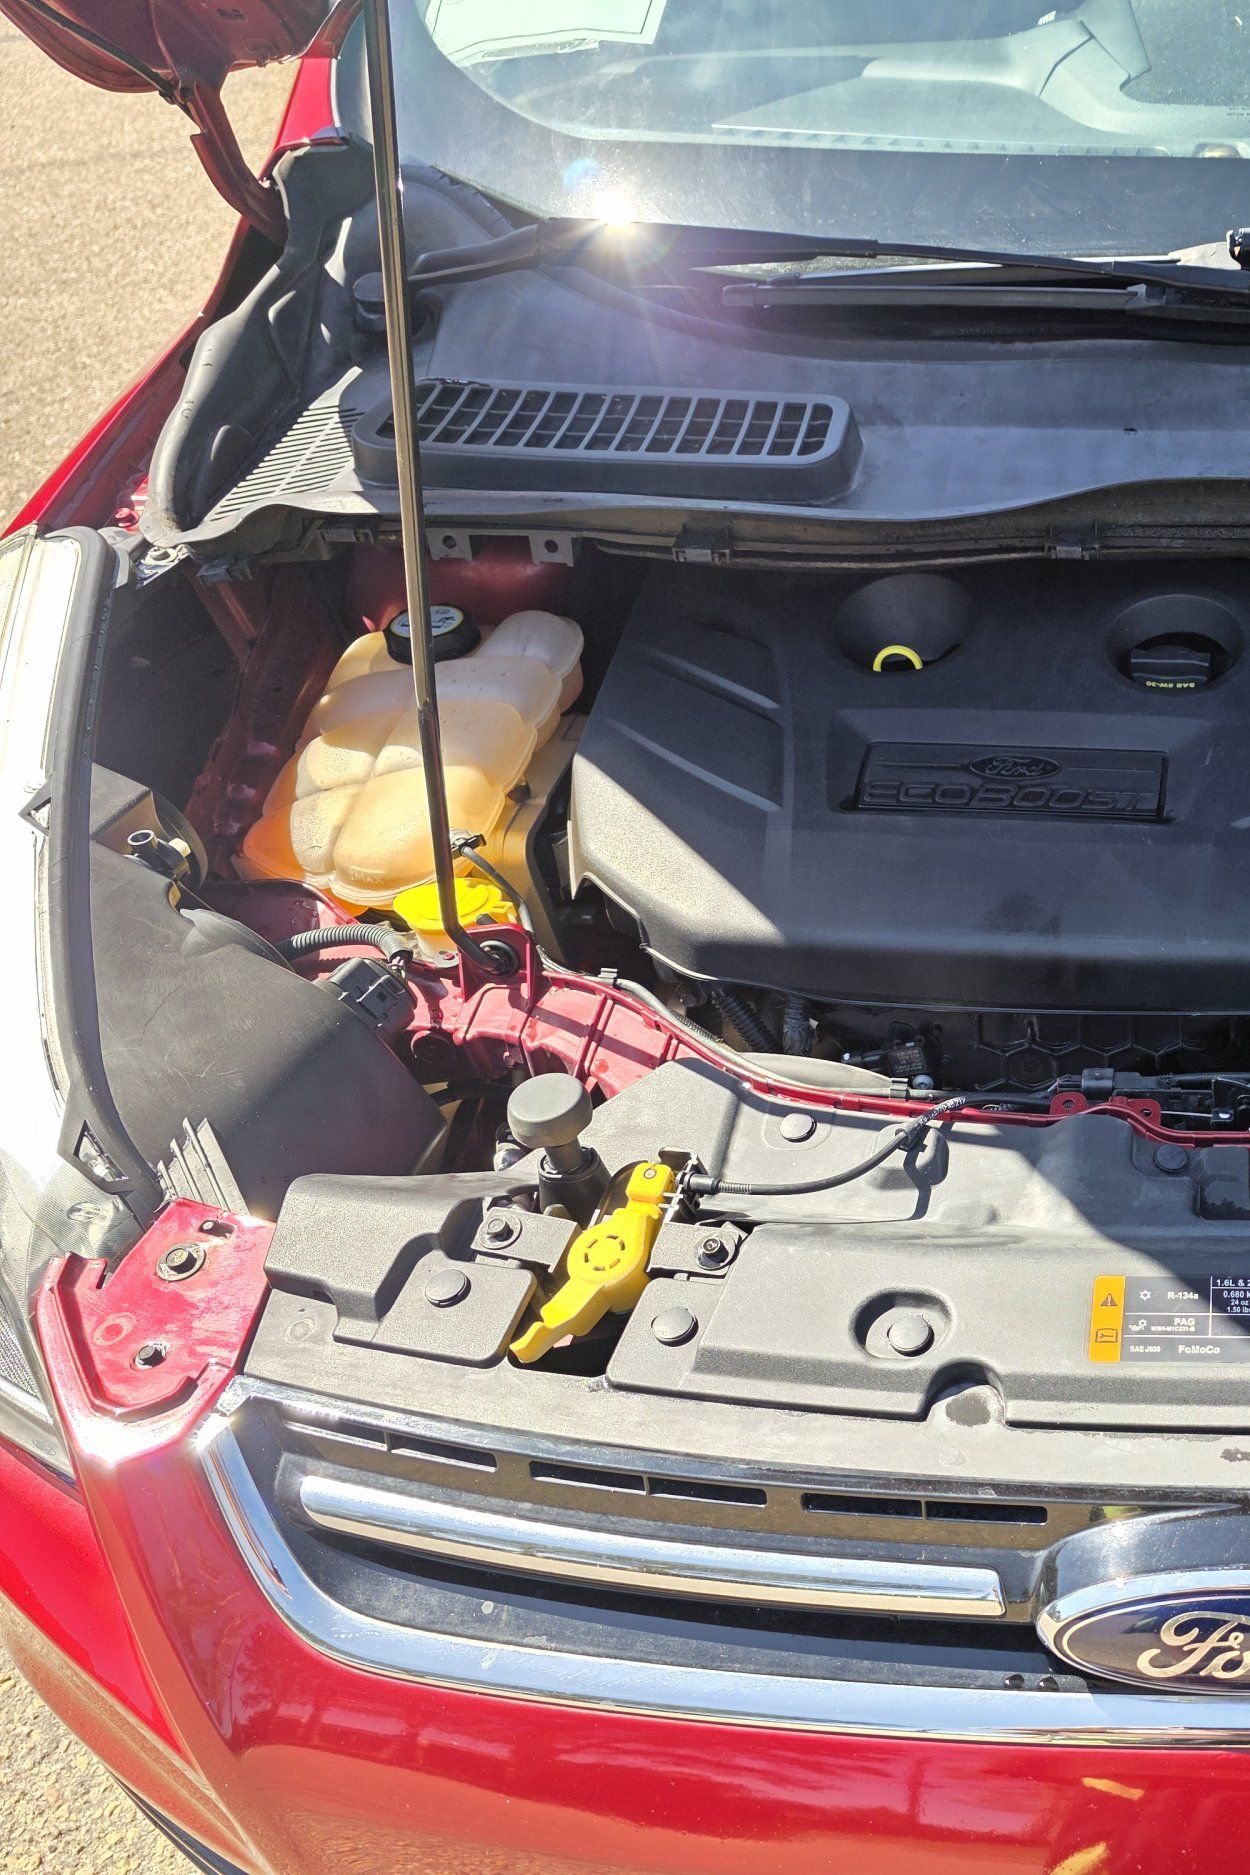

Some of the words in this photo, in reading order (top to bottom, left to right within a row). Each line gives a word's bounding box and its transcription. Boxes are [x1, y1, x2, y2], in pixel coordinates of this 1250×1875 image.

[984, 756, 1047, 777] Ford
[862, 781, 1159, 811] ECOBOOST
[1216, 1279, 1235, 1287] 1.6L
[1237, 1279, 1245, 1287] &
[1167, 1291, 1199, 1300] R-134a
[1223, 1290, 1245, 1298] 0.680
[1174, 1317, 1196, 1326] PAG
[1129, 1345, 1144, 1353] SAE
[1178, 1345, 1221, 1354] FoMoCo
